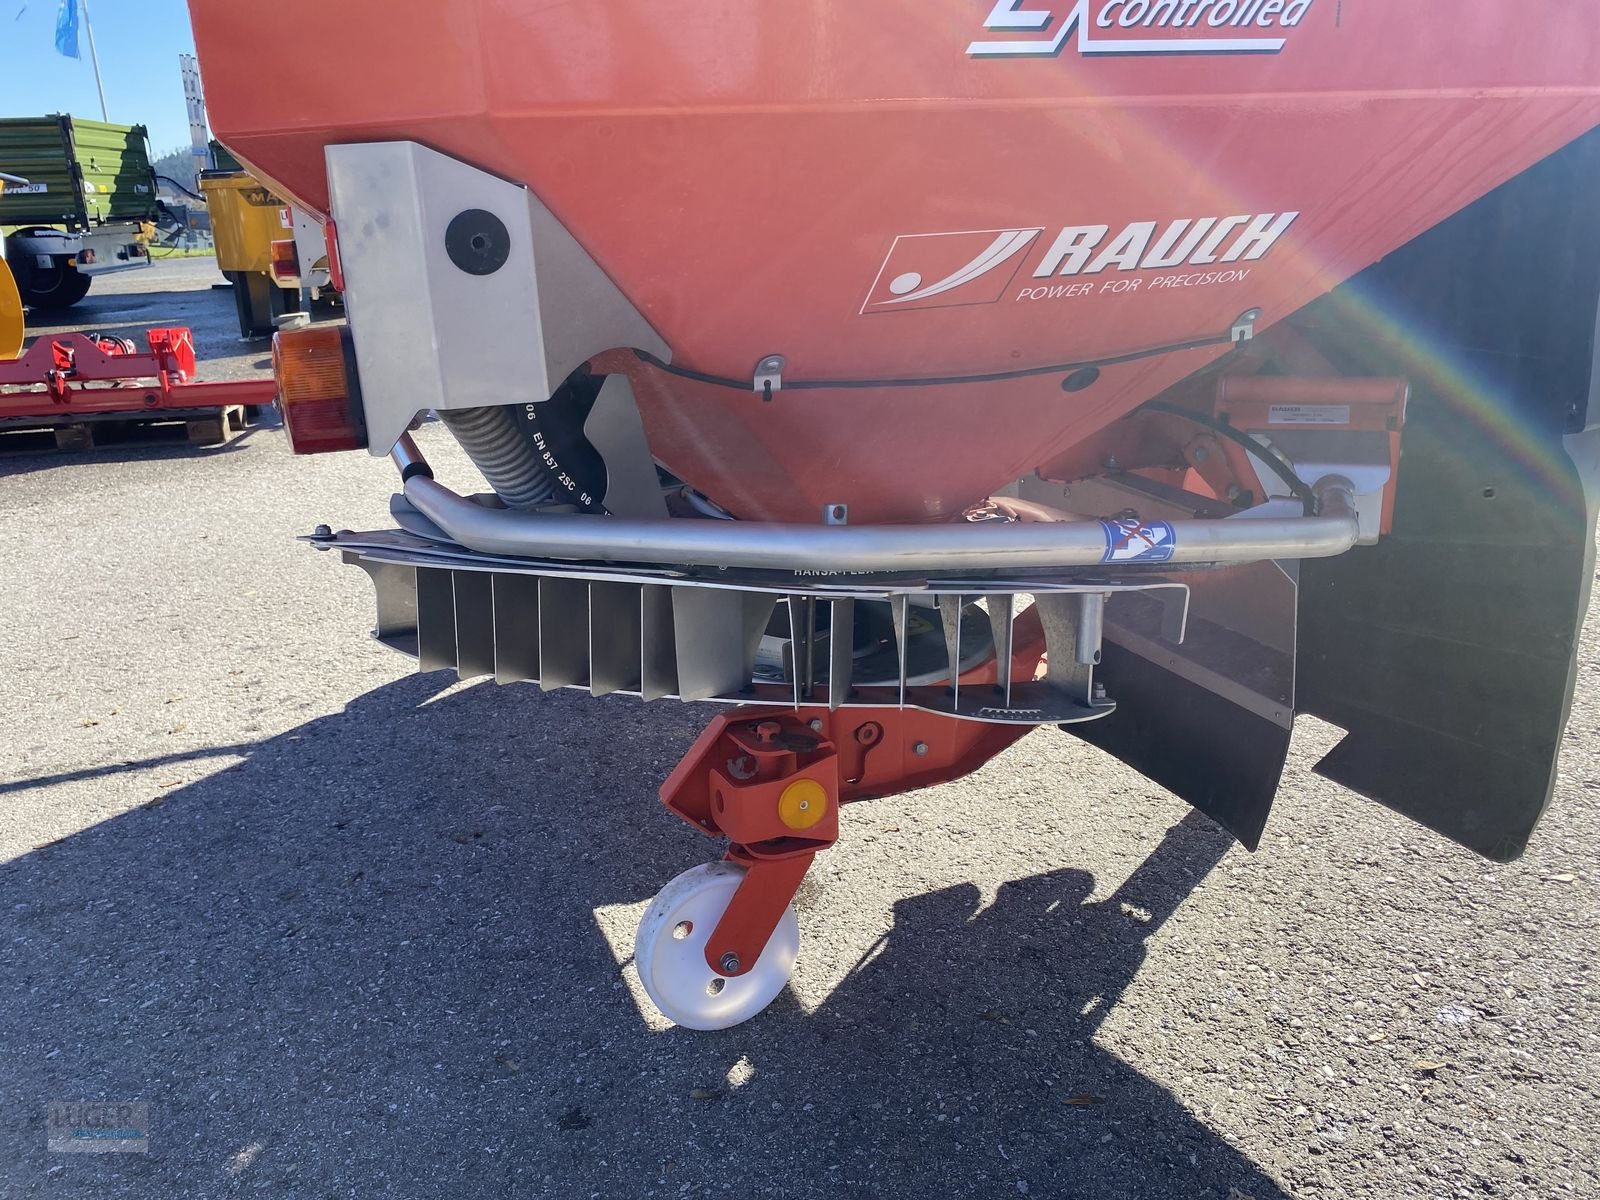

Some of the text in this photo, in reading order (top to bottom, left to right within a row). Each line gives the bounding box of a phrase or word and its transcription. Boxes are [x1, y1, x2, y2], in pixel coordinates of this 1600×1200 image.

[1096, 0, 1313, 27] controlled
[1032, 211, 1299, 279] RAUCH
[1016, 269, 1251, 301] POWER FOR PRECISION
[526, 404, 591, 505] 06 EN 857 2SC 06
